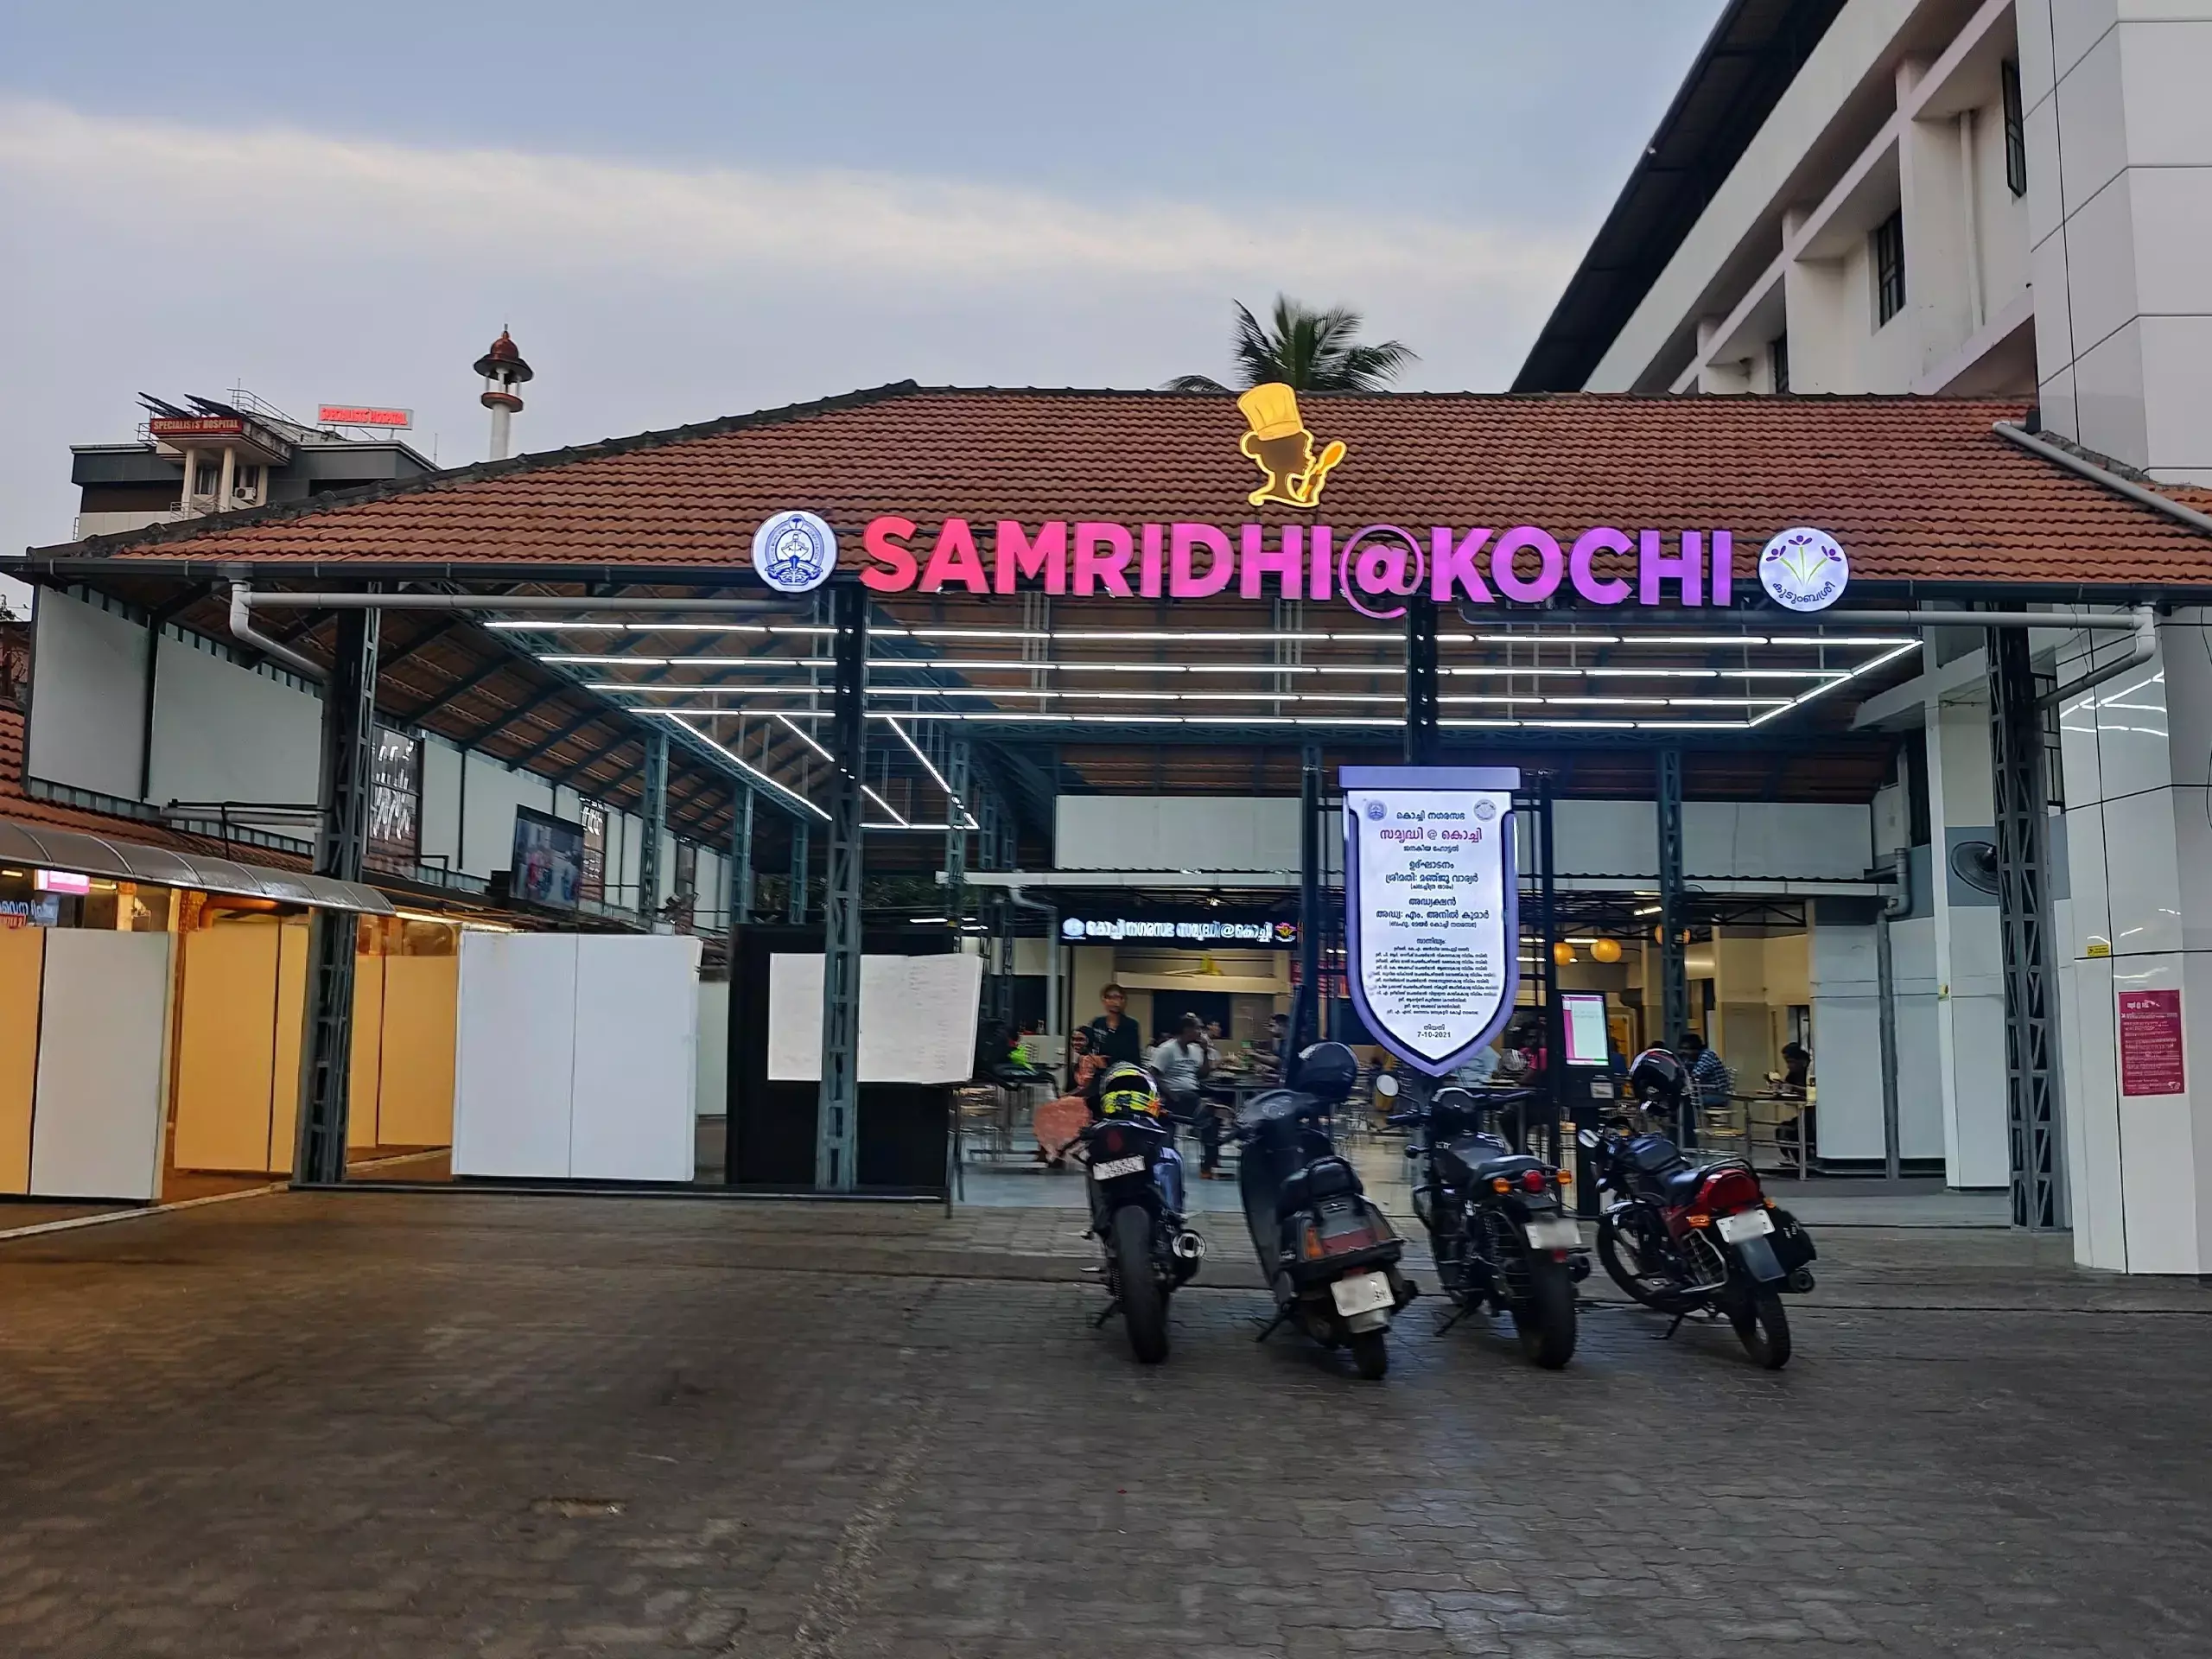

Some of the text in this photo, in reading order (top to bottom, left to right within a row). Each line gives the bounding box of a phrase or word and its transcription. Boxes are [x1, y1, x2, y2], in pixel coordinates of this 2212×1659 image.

[203, 419, 238, 429] HOSPITAL
[1772, 581, 1835, 604] കുടുംബശ്രീ
[1396, 810, 1426, 822] കൊച്ചി
[1427, 811, 1465, 821] നഗരസഭ
[1380, 827, 1483, 843] സമൃദ്ധി @ കൊച്ചി
